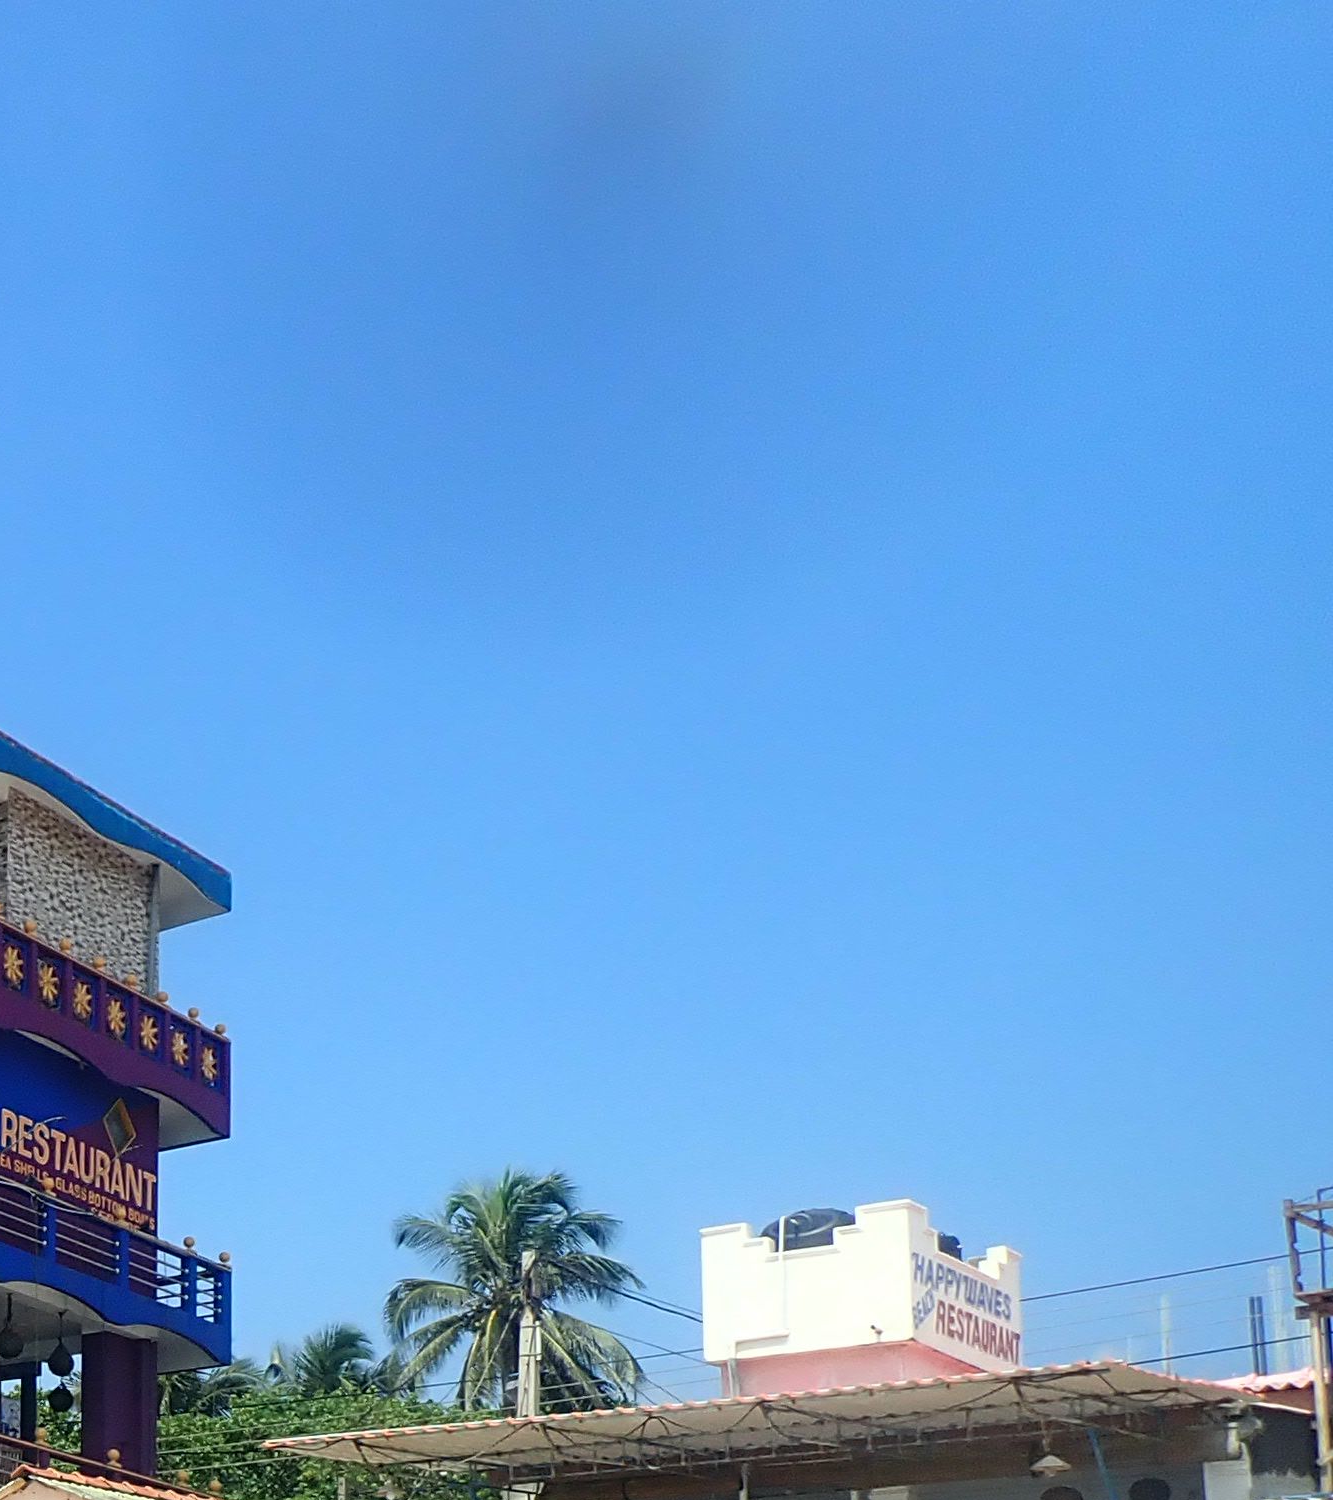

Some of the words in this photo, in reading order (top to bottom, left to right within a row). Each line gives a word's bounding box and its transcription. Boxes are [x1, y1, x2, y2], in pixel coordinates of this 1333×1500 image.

[1, 1108, 157, 1212] RESTAURANT
[55, 1177, 88, 1202] GLASS
[912, 1252, 962, 1299] HAPPY
[962, 1274, 1012, 1321] WAVES
[935, 1299, 1021, 1366] RESTAURANT
